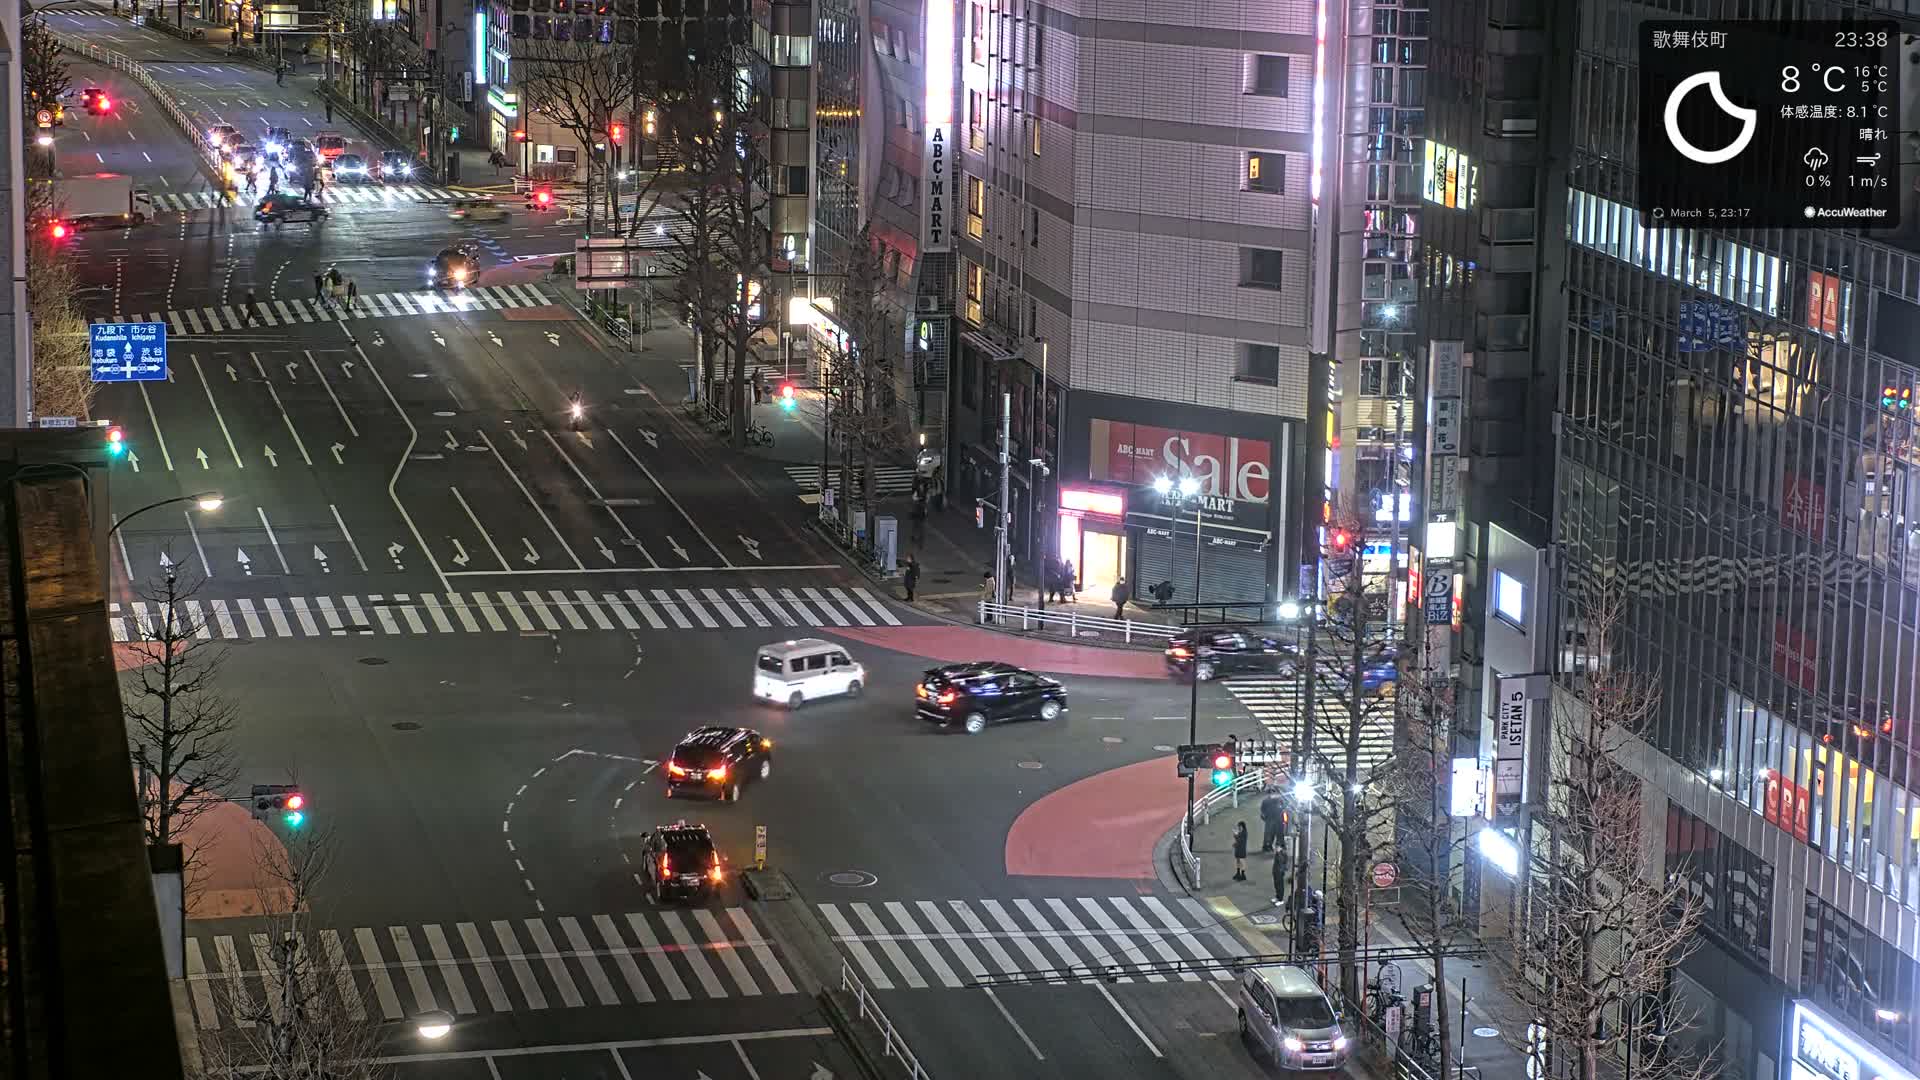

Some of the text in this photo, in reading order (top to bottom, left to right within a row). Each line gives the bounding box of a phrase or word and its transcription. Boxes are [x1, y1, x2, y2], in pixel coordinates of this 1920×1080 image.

[930, 128, 944, 243] ABC-MART
[97, 325, 125, 335] 九段下
[131, 334, 156, 342] Ichigaya
[141, 347, 163, 356] 渋谷
[1117, 443, 1155, 457] ABC-MART
[1163, 437, 1270, 504] Sale
[1501, 702, 1510, 740] PARK CITY
[1510, 691, 1524, 746] ISETAN 5
[1768, 779, 1808, 829] CPA
